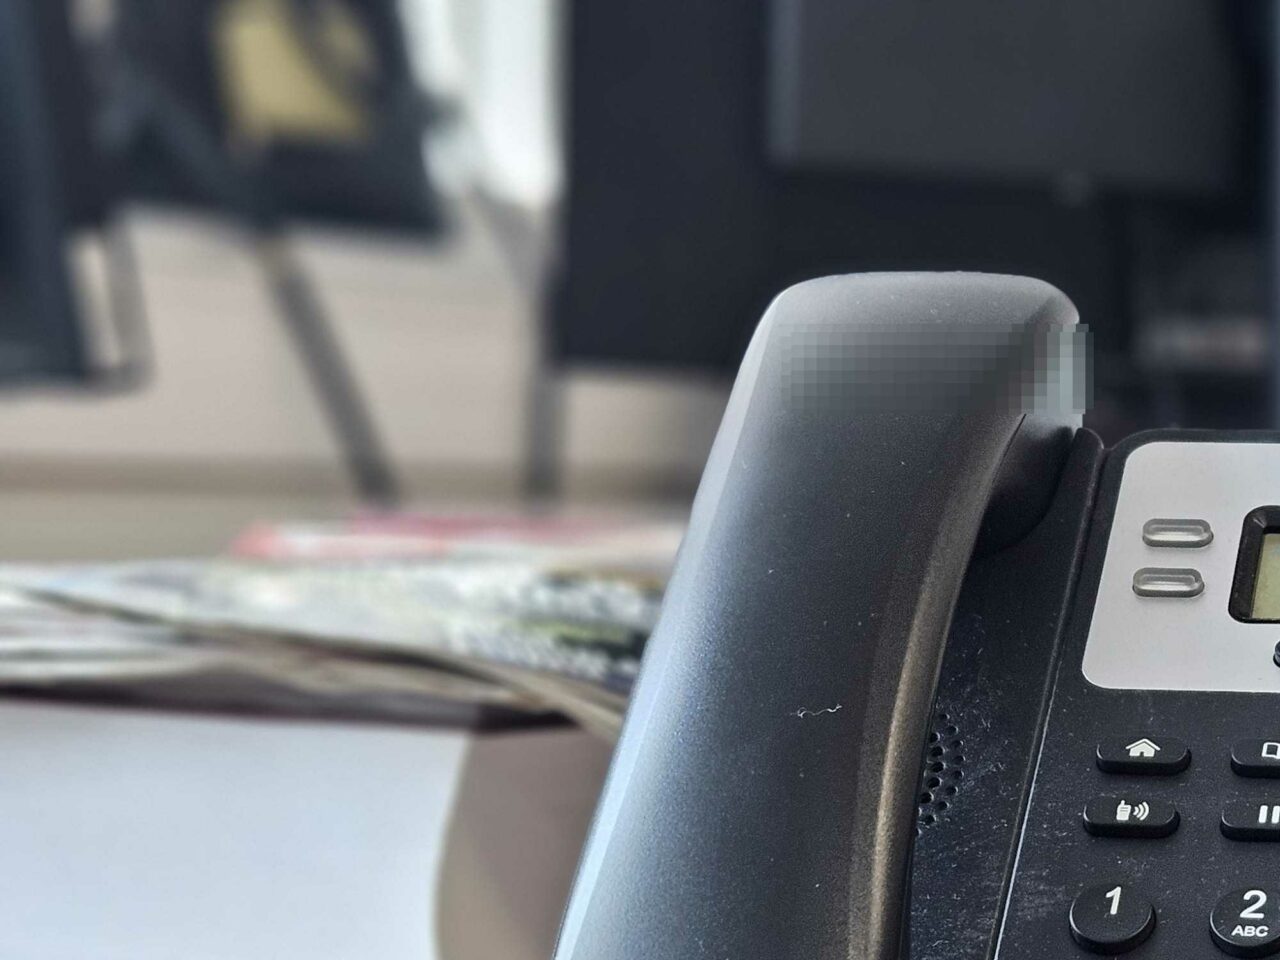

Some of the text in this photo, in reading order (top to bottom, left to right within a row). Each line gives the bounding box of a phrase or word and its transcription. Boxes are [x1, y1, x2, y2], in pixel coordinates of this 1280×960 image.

[1105, 886, 1122, 915] 1
[1239, 889, 1267, 919] 2
[1231, 924, 1269, 938] ABC
